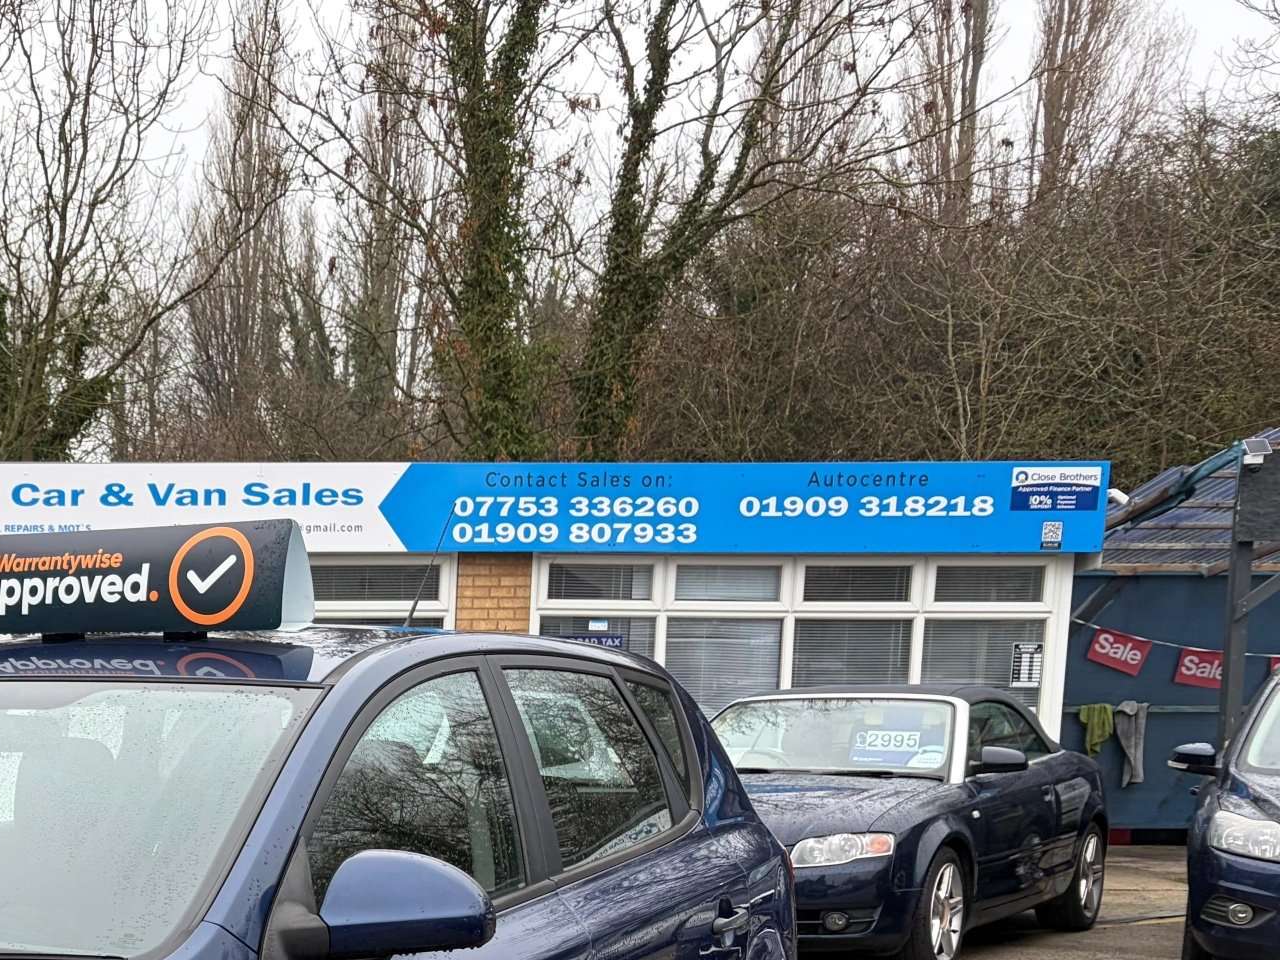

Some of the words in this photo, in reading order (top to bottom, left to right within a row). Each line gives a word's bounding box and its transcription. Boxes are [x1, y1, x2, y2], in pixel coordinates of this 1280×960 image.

[485, 471, 567, 488] Contact
[577, 471, 631, 488] Sales
[641, 474, 672, 488] on:
[807, 472, 929, 487] Autocentre
[1031, 472, 1057, 482] Close
[1059, 472, 1098, 481] Brothers
[11, 483, 85, 507] Car
[99, 482, 134, 507] &
[147, 482, 226, 507] Van
[241, 482, 365, 507] Sales
[453, 496, 559, 517] 07753
[569, 496, 699, 517] 336260
[739, 496, 848, 517] 01909
[858, 495, 994, 517] 318218
[4, 524, 45, 533] REPAIRS
[452, 523, 559, 544] 01909
[569, 523, 697, 544] 807933
[601, 638, 621, 647] TAX
[1095, 634, 1142, 665] Sale
[855, 731, 918, 749] £2995
